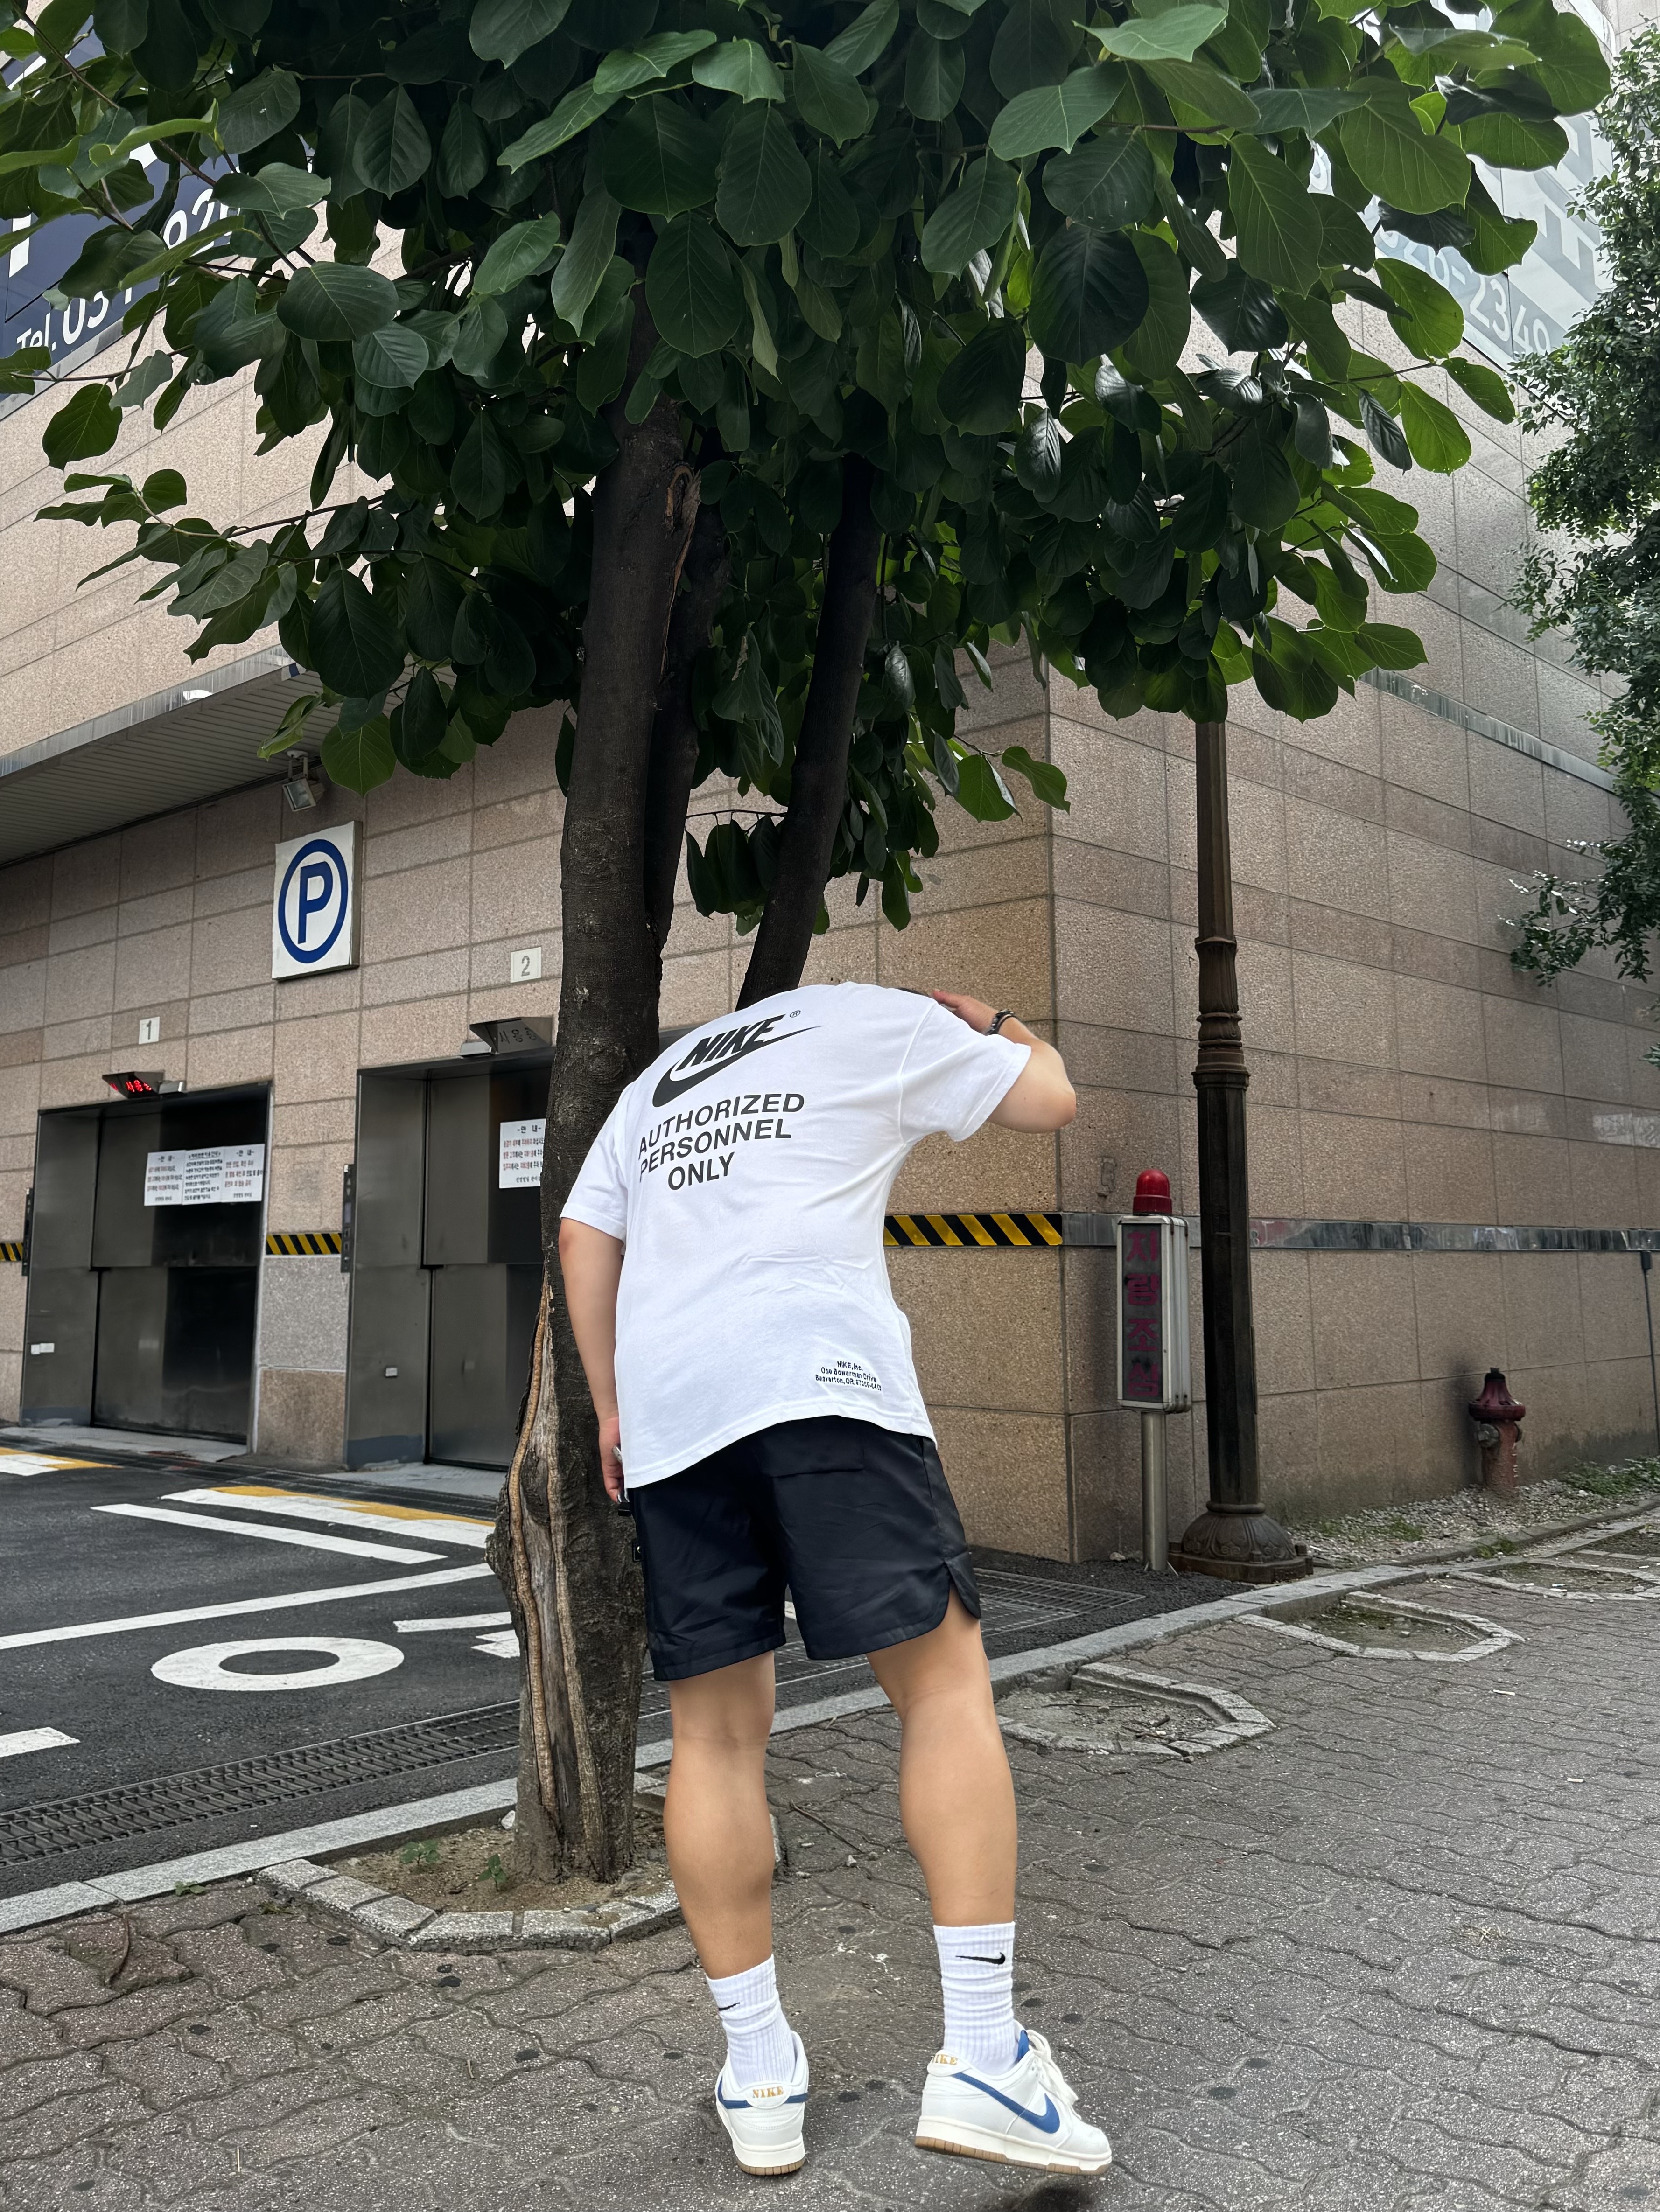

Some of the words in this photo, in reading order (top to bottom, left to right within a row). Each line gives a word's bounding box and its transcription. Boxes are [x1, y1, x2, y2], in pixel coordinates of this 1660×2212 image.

[298, 861, 333, 944] P
[521, 956, 530, 977] 2
[146, 1020, 152, 1040] 1
[675, 1014, 786, 1071] NIKE
[638, 1093, 805, 1160] AUTHORIZED
[639, 1118, 792, 1183] PERSONNEL
[668, 1151, 735, 1191] ONLY
[933, 2054, 958, 2066] IKE
[752, 2086, 784, 2099] NIKE
